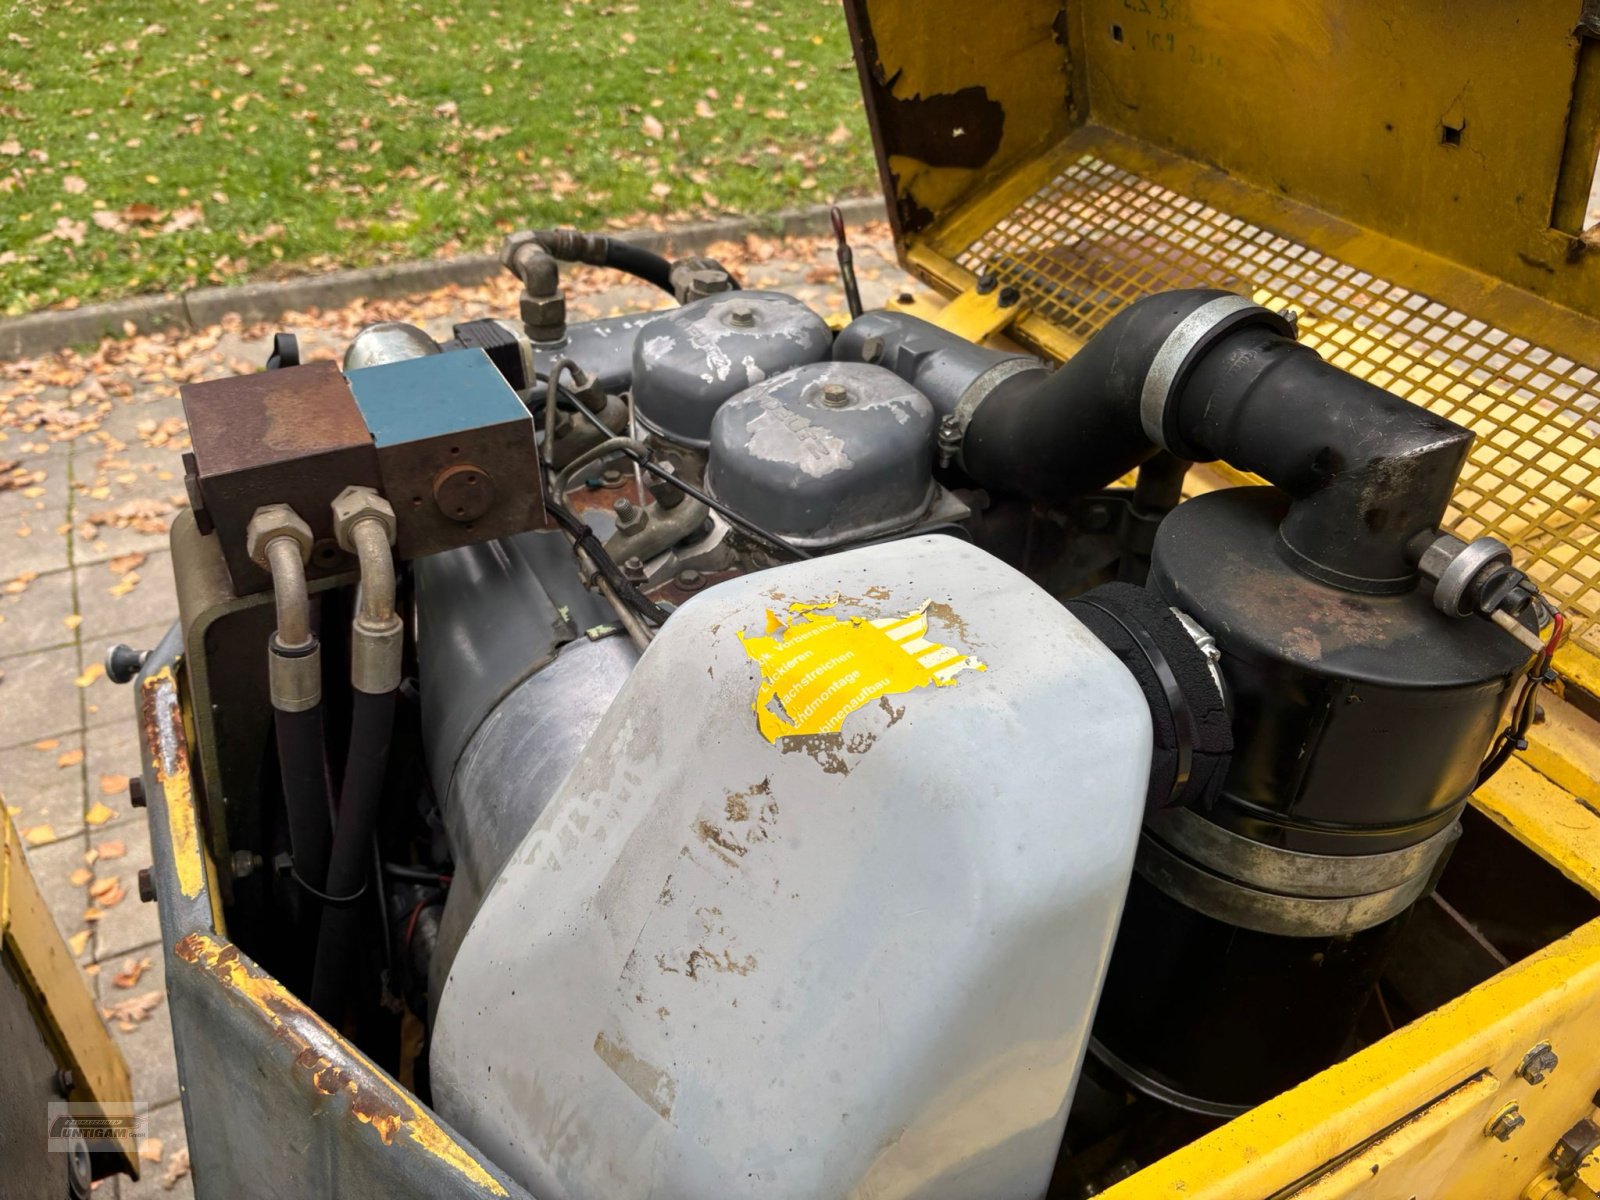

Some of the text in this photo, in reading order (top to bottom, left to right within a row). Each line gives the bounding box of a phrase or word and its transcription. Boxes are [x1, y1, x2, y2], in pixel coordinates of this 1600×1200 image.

[774, 621, 848, 651] Vorbereitun
[781, 651, 856, 706] achstreichen
[819, 678, 891, 733] binenaufbau
